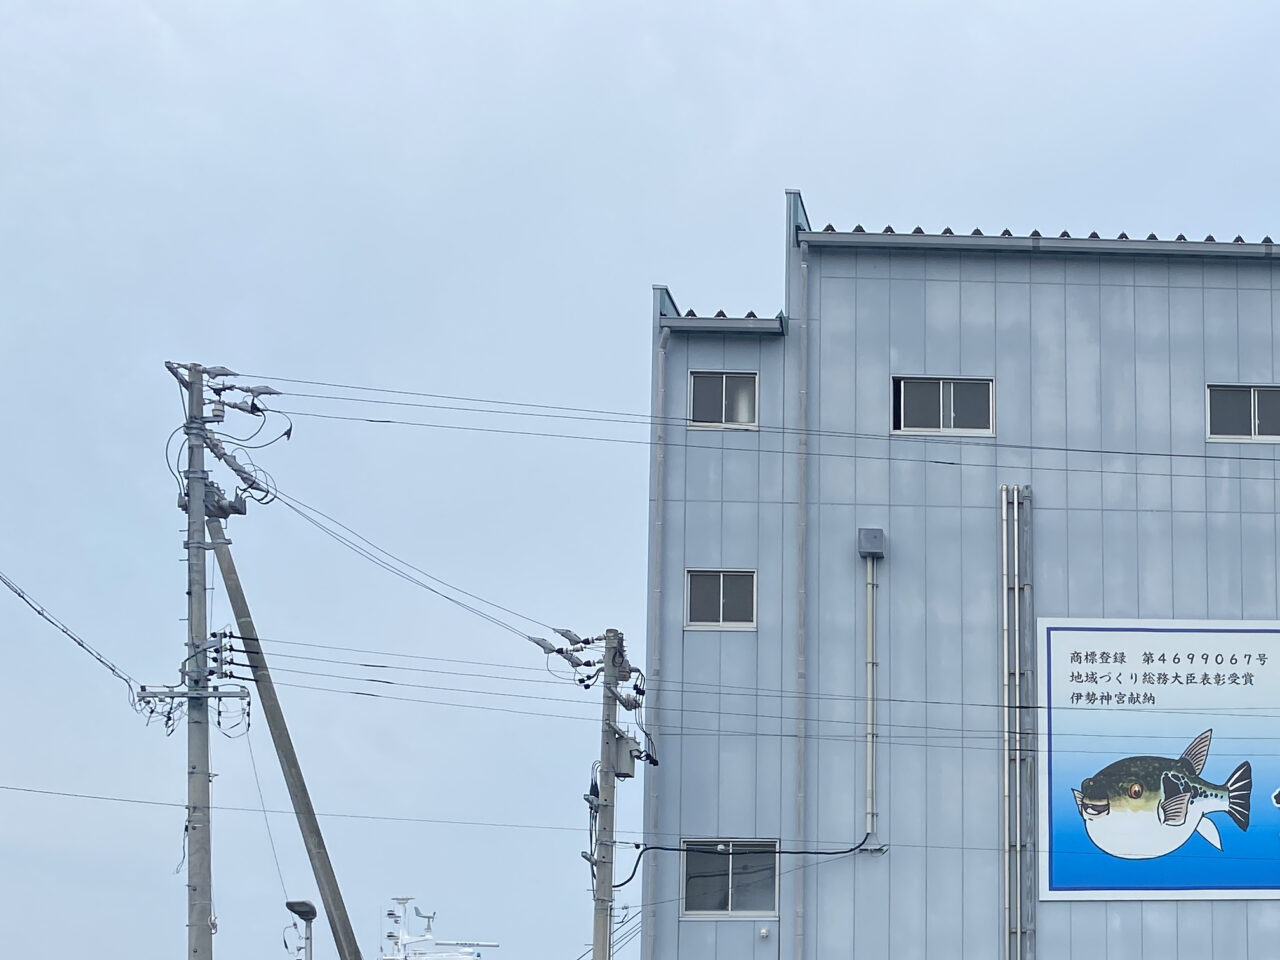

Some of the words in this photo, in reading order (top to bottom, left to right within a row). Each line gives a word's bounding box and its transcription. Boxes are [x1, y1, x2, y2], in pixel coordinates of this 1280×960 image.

[1070, 651, 1127, 665] 商標登録
[1141, 651, 1269, 666] 第4699067号
[1069, 671, 1255, 686] 地域づくり総務大臣表彰受賞
[1070, 691, 1156, 706] 伊勢神宮献納
